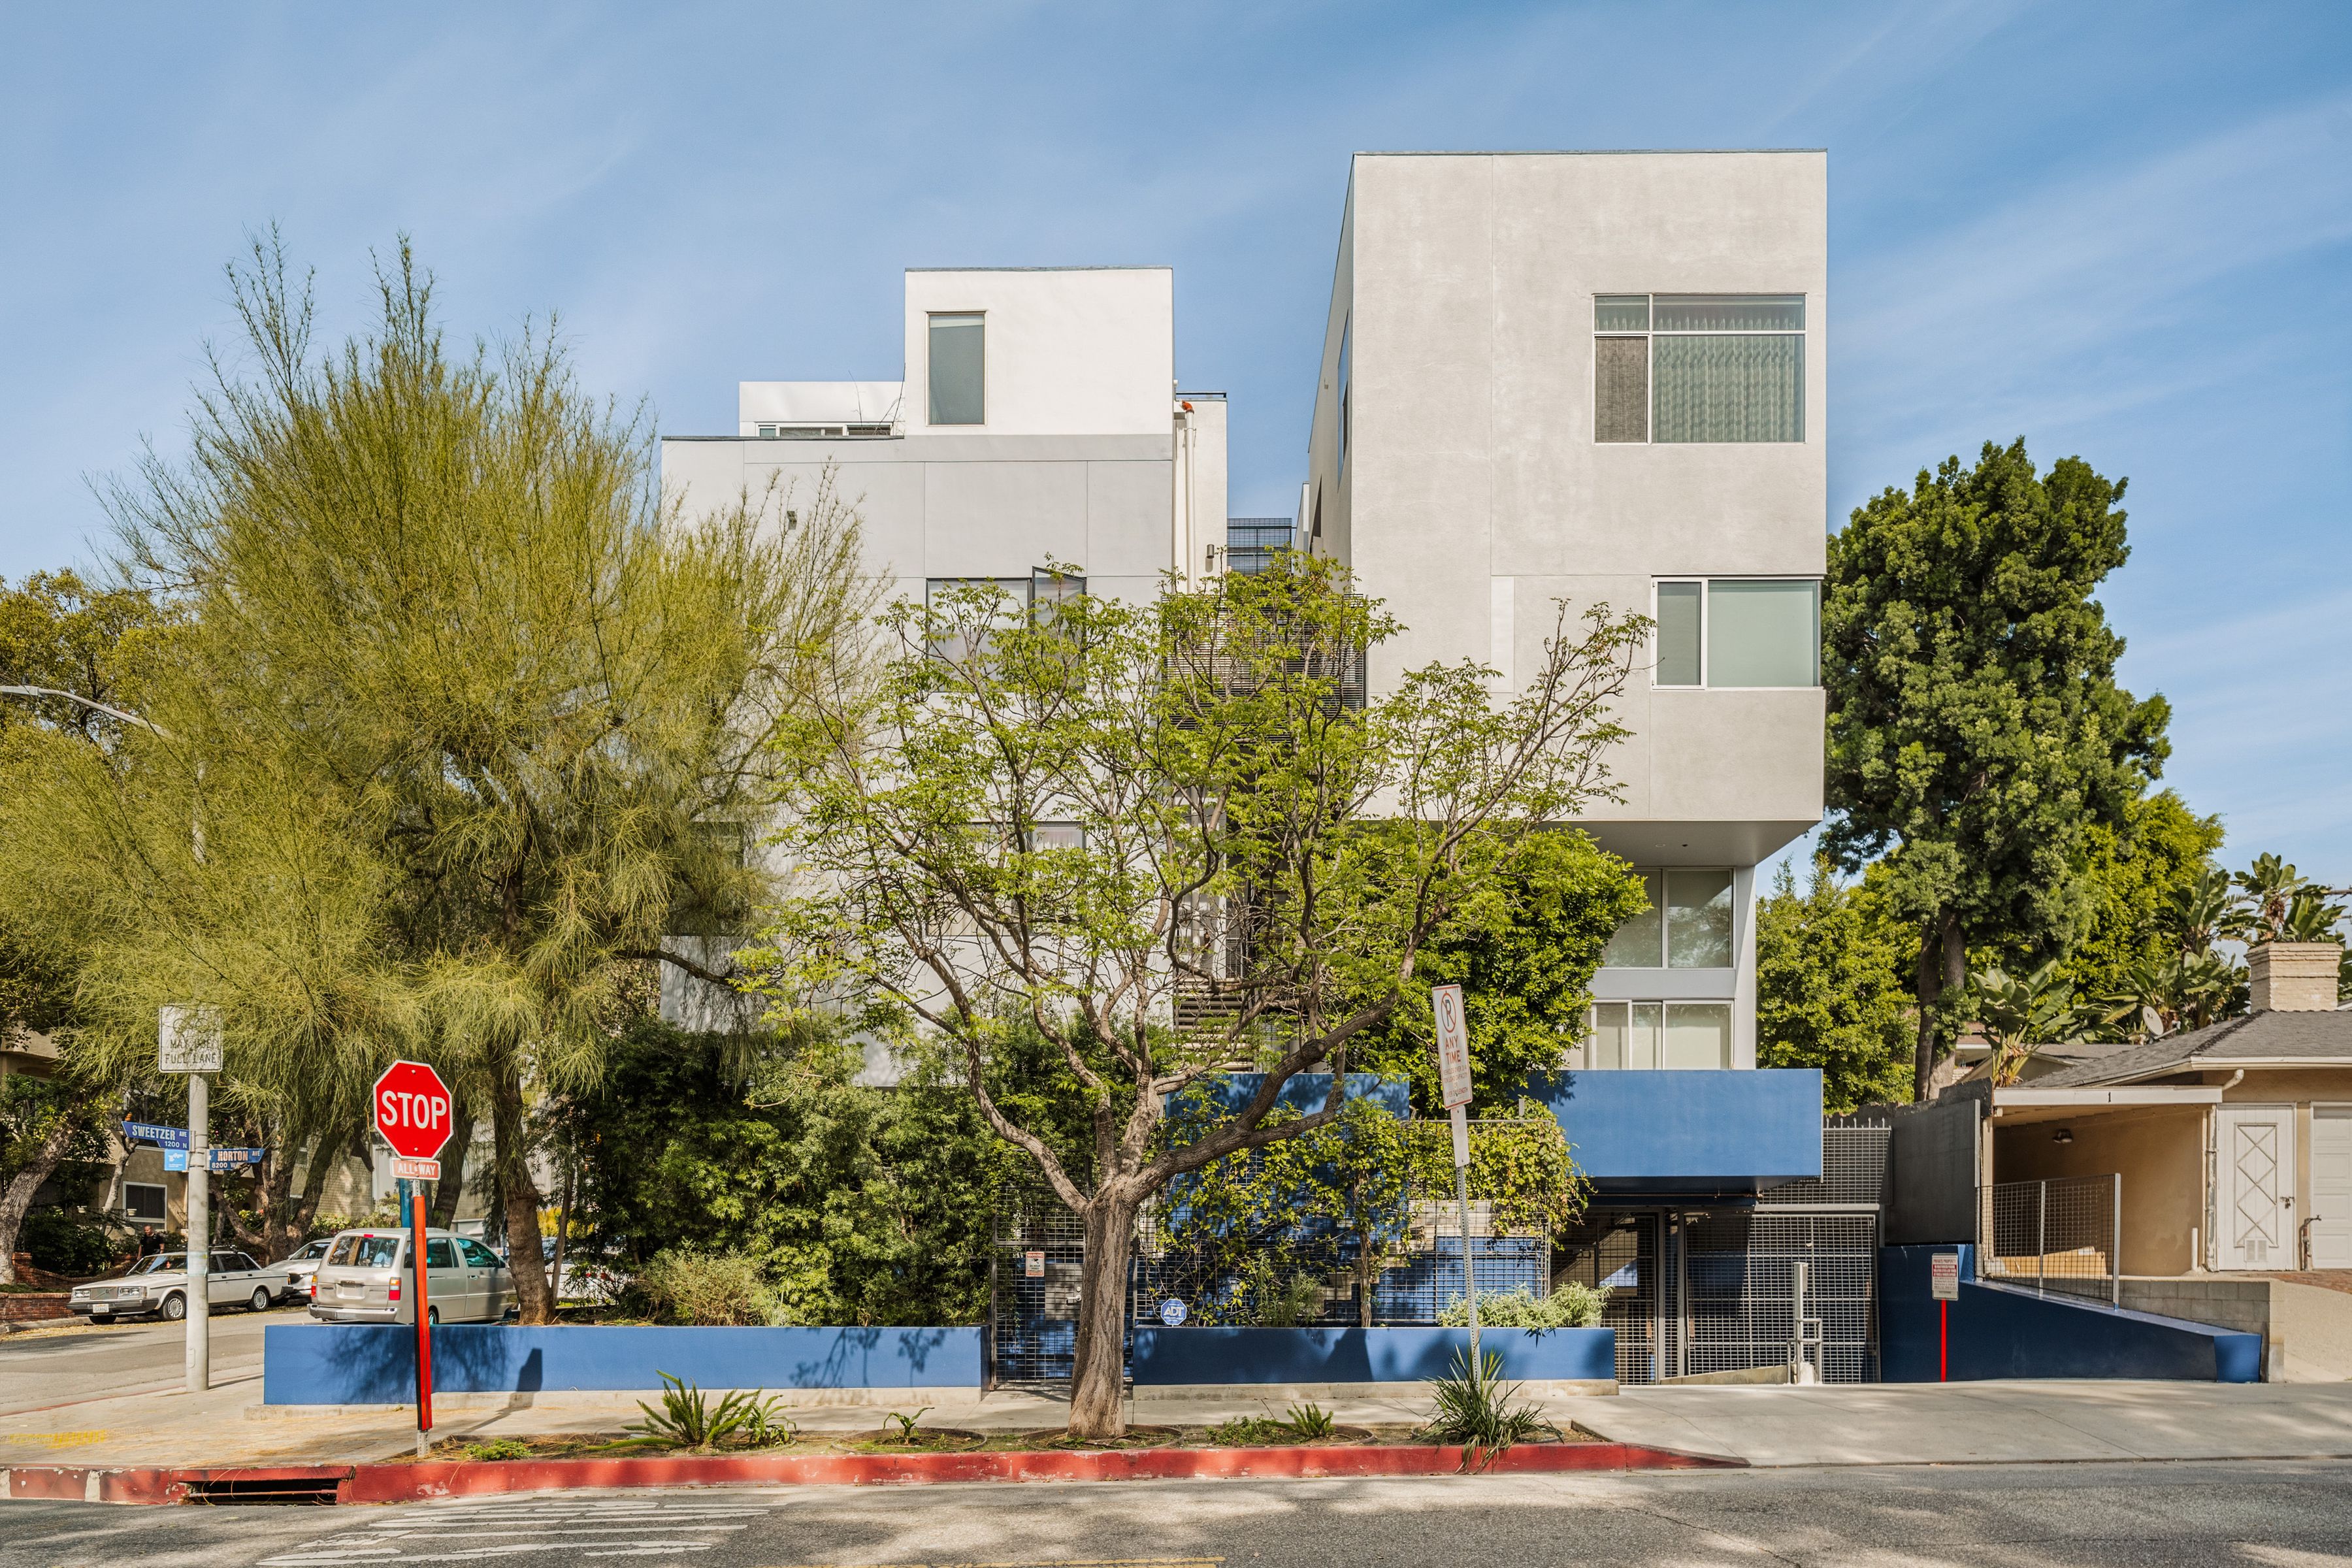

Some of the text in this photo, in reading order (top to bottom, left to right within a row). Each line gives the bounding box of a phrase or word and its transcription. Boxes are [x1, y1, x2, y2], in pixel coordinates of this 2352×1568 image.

[170, 1039, 188, 1049] MAY
[1445, 1035, 1458, 1050] ANY
[165, 1053, 216, 1064] FULL LANE
[1446, 1050, 1461, 1065] TIME
[381, 1090, 447, 1130] STOP
[132, 1125, 176, 1141] SWEETZER
[218, 1151, 248, 1162] HORTON
[1164, 1306, 1184, 1316] ADT
